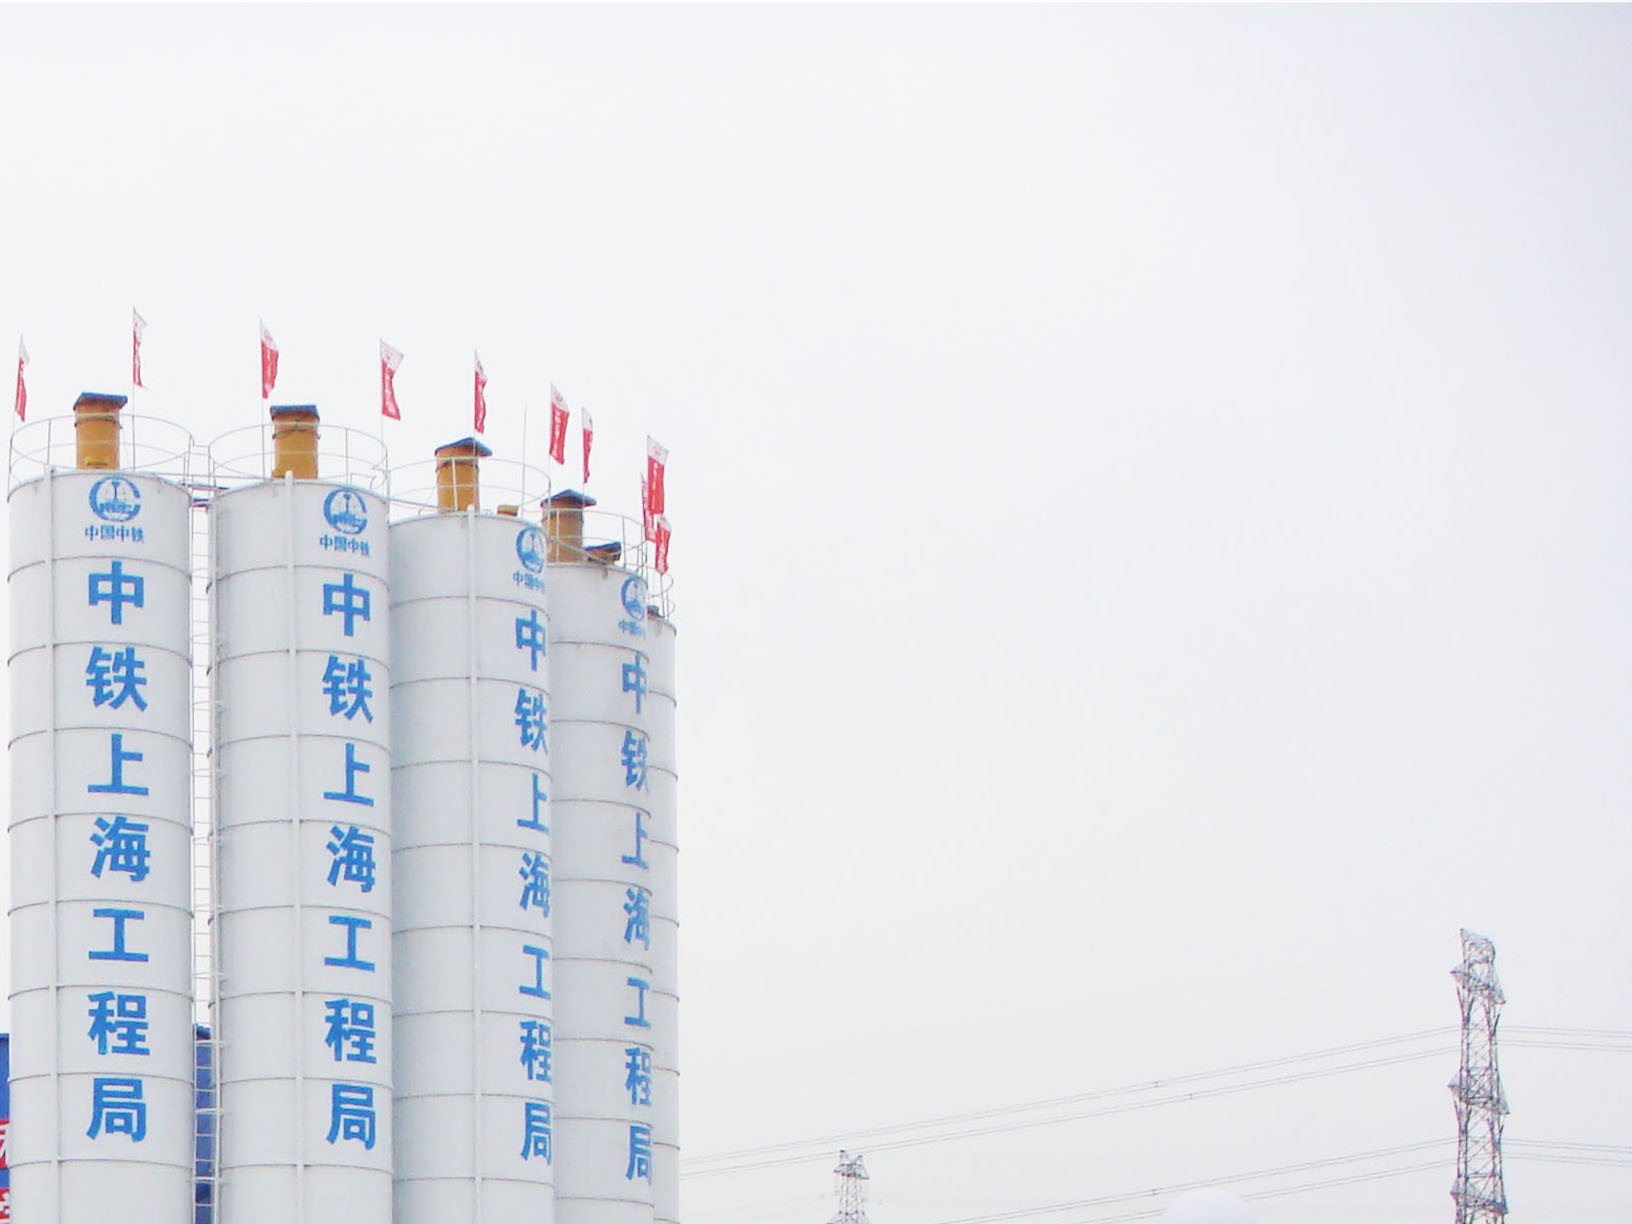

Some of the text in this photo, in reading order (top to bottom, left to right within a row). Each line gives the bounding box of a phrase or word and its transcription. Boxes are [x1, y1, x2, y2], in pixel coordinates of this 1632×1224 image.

[84, 560, 150, 1143] 中铁上海工程局
[322, 573, 377, 1151] 中铁上海工程局
[514, 608, 553, 1166] 中铁上海工程局
[620, 653, 654, 1186] 中铁上海工程局
